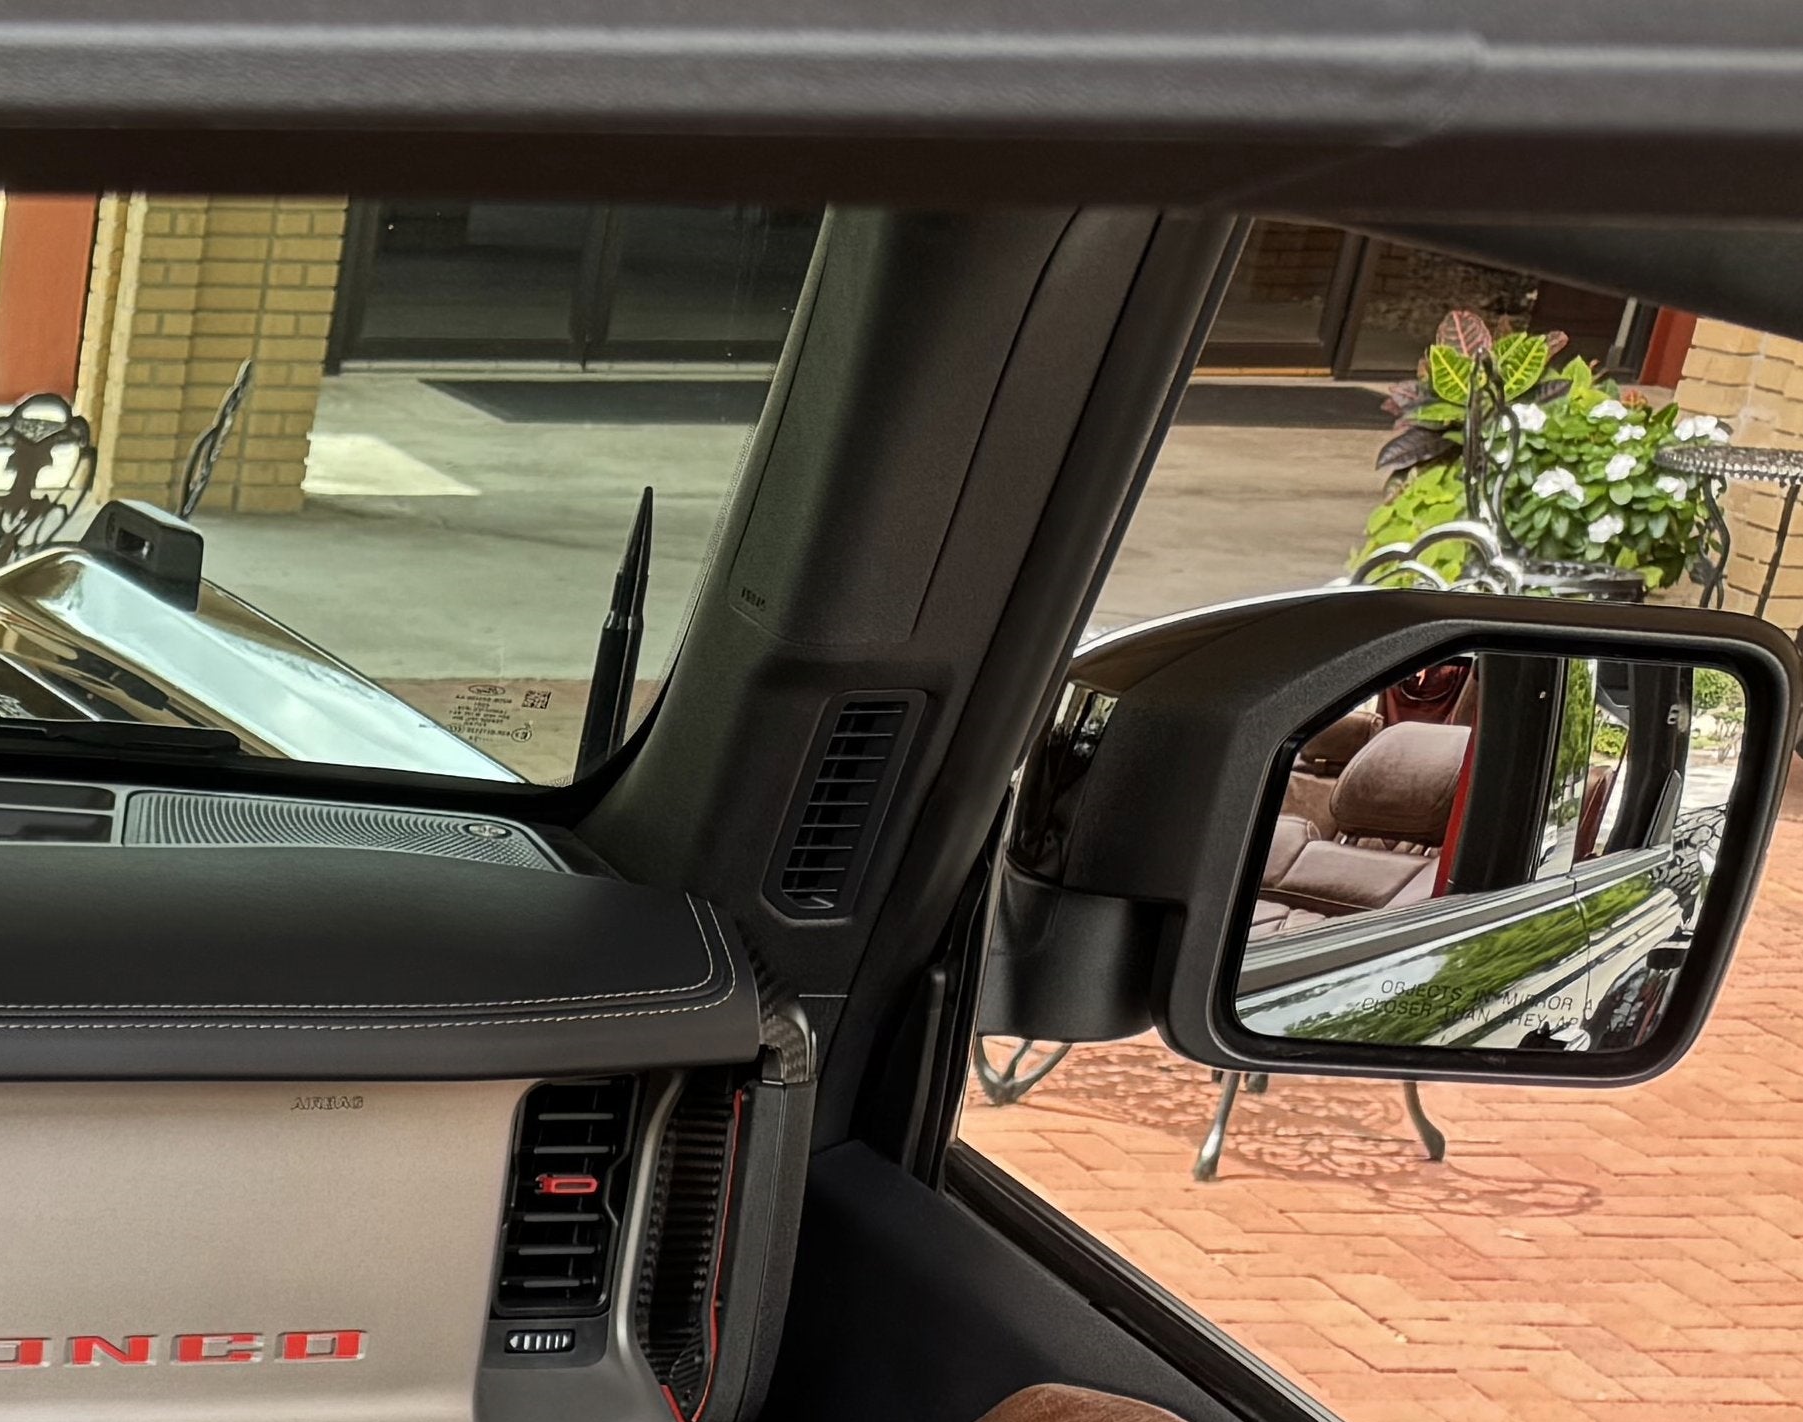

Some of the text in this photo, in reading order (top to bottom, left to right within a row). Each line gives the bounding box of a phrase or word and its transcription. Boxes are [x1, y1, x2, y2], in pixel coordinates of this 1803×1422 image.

[1381, 980, 1463, 1001] OBJECTS
[1362, 998, 1432, 1017] CLOSER
[290, 1095, 364, 1110] AIRBAG
